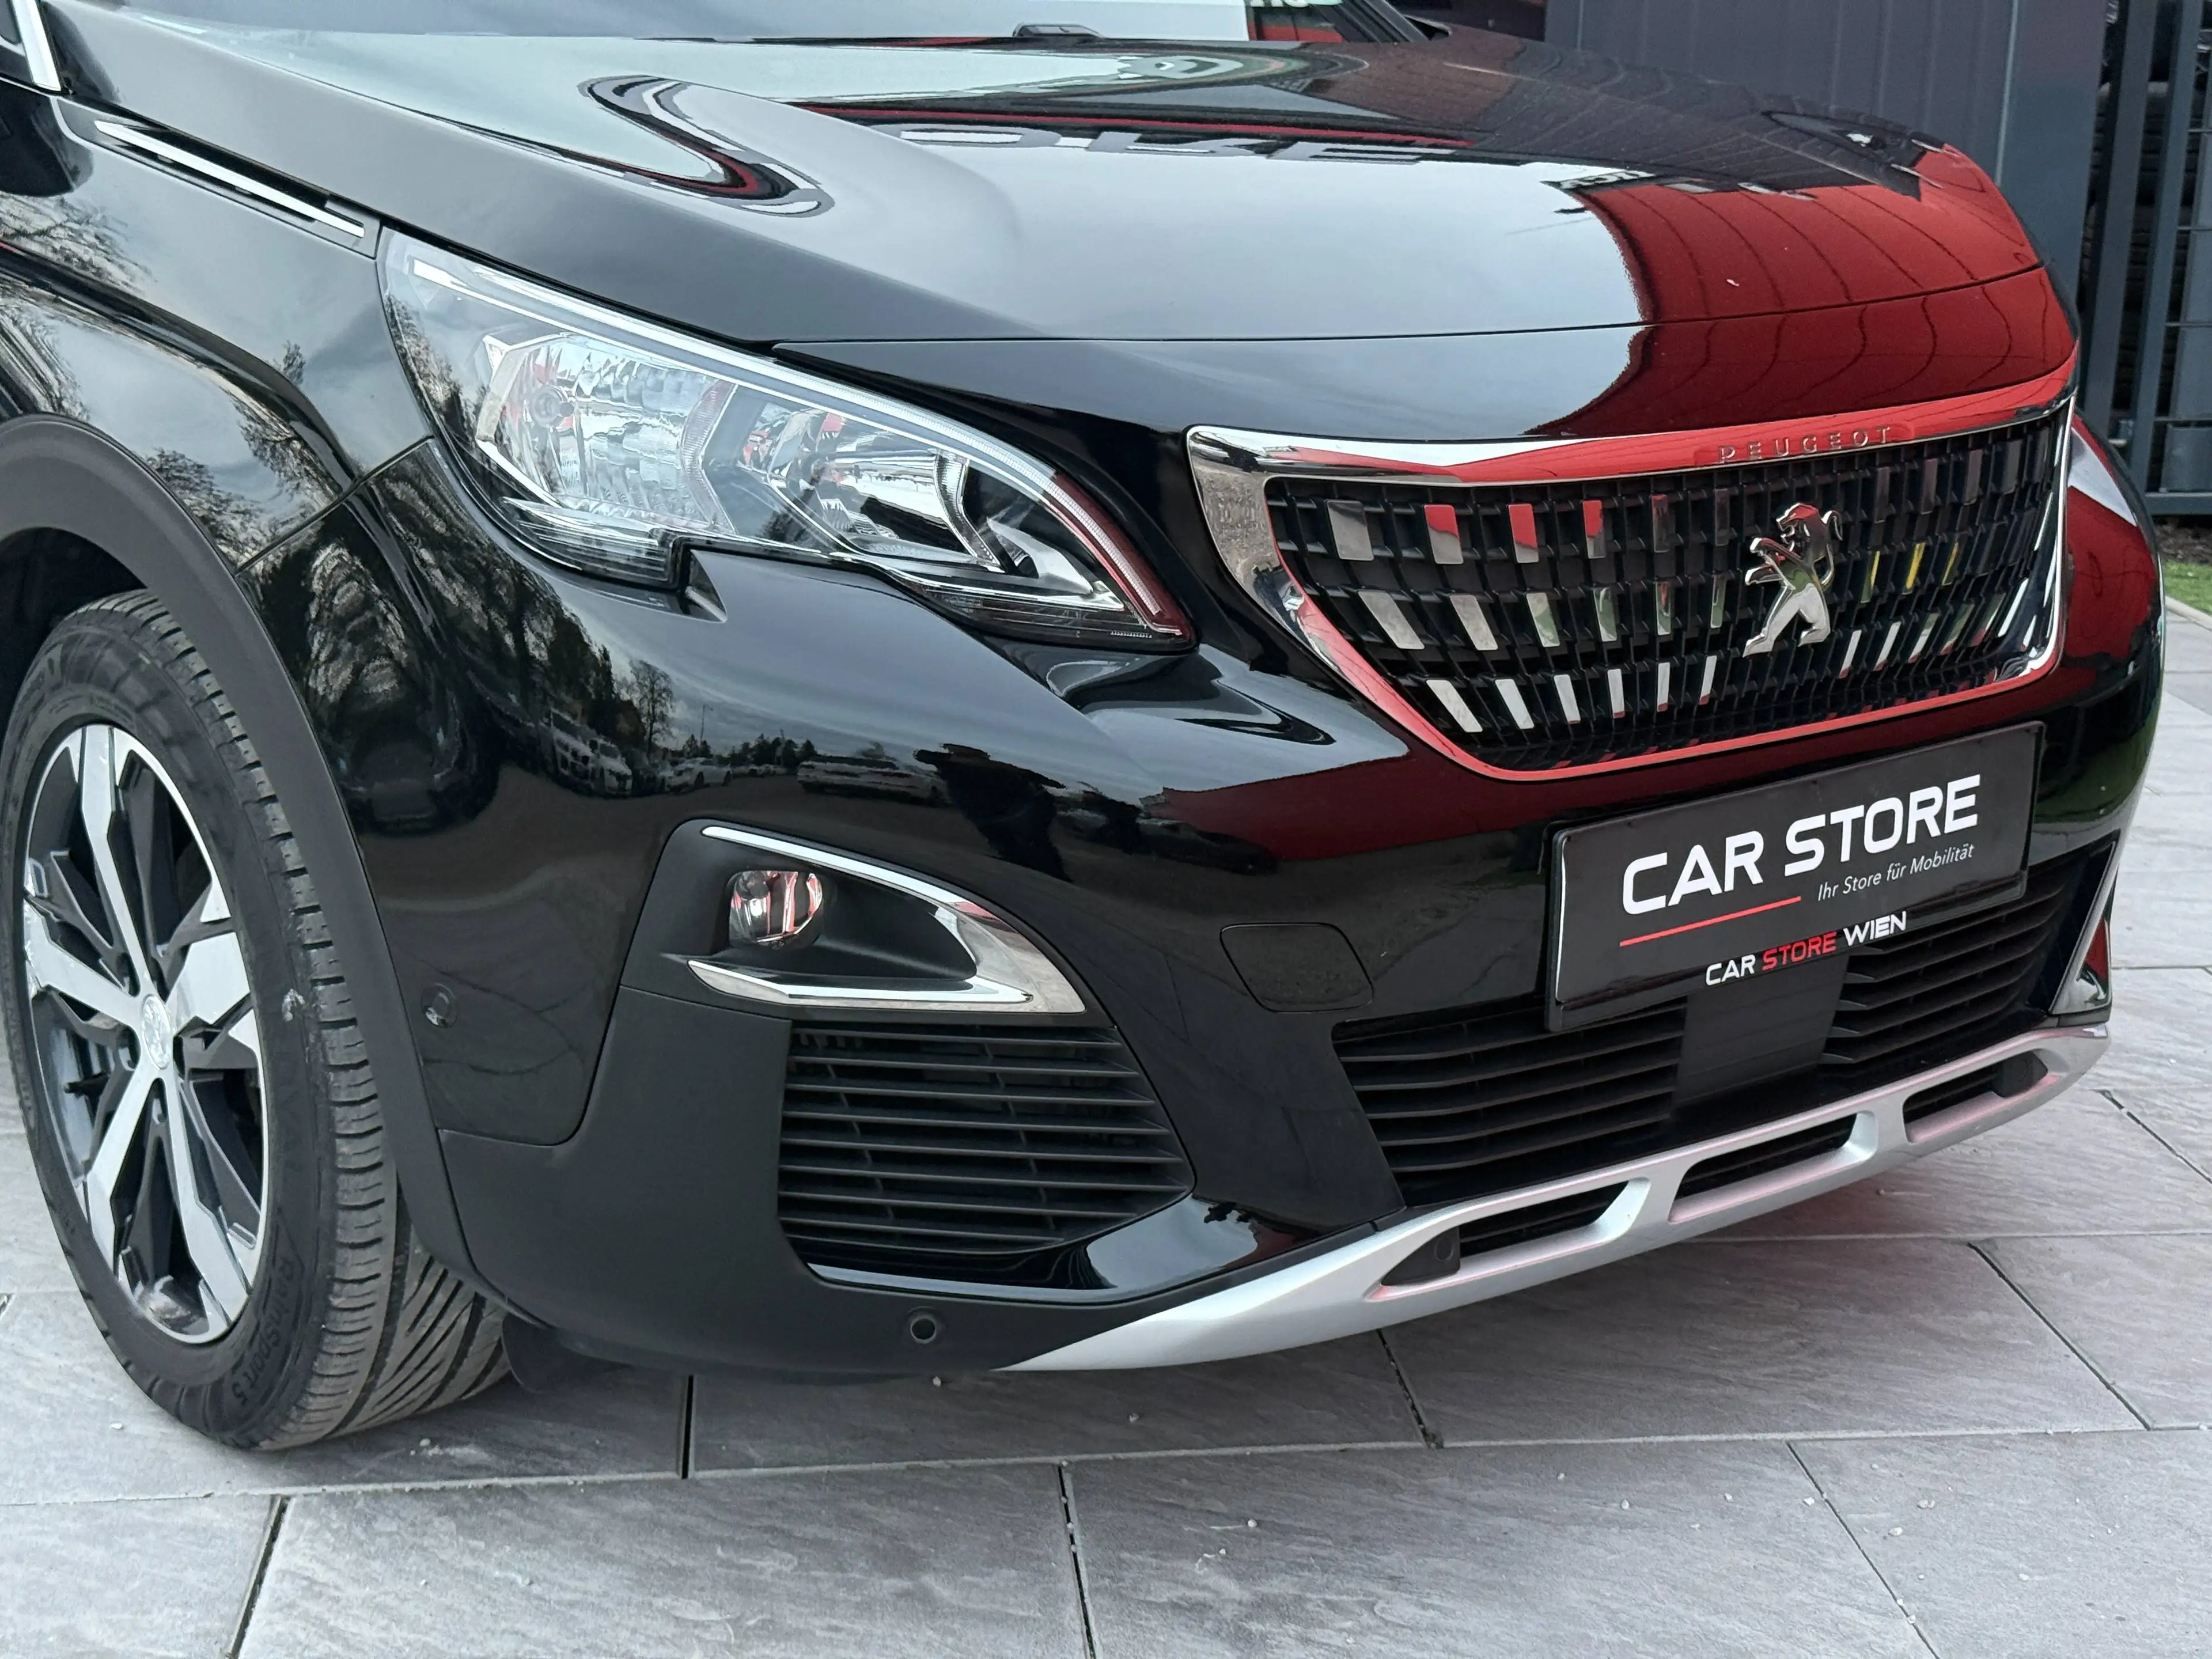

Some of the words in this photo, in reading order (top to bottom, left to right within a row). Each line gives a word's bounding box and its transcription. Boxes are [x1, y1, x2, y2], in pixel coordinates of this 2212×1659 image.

[1718, 426, 1890, 464] PEUGEOT
[1622, 831, 1764, 915] CAR
[1784, 774, 1981, 876] STORE
[1817, 881, 1839, 901] Ihr
[1843, 872, 1882, 894] Store
[1887, 863, 1907, 882] für
[1910, 843, 1975, 875] Mobilität
[1706, 954, 1756, 986] CAR
[1762, 931, 1837, 971] STORE
[1843, 911, 1907, 946] WIEN
